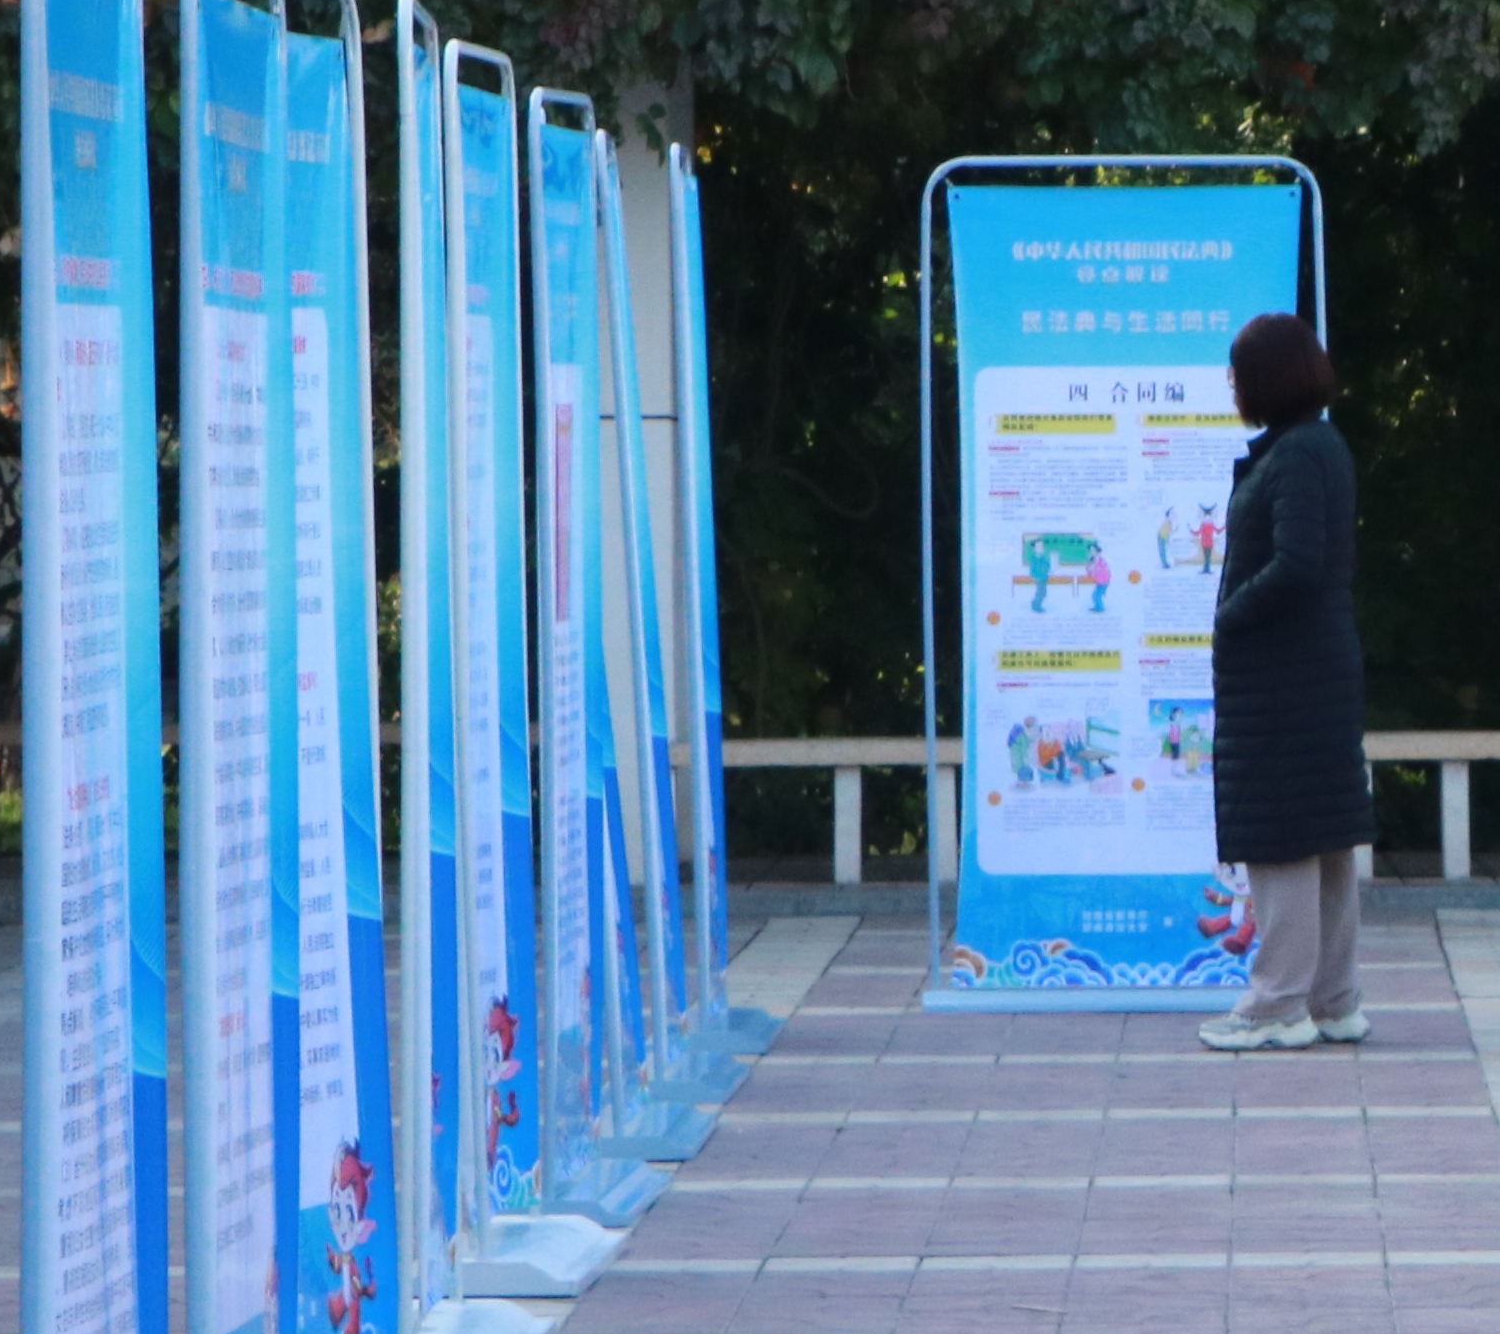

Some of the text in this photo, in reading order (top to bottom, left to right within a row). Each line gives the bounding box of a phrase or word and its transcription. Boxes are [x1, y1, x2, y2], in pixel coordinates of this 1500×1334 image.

[1068, 380, 1186, 404] 四 合同编
